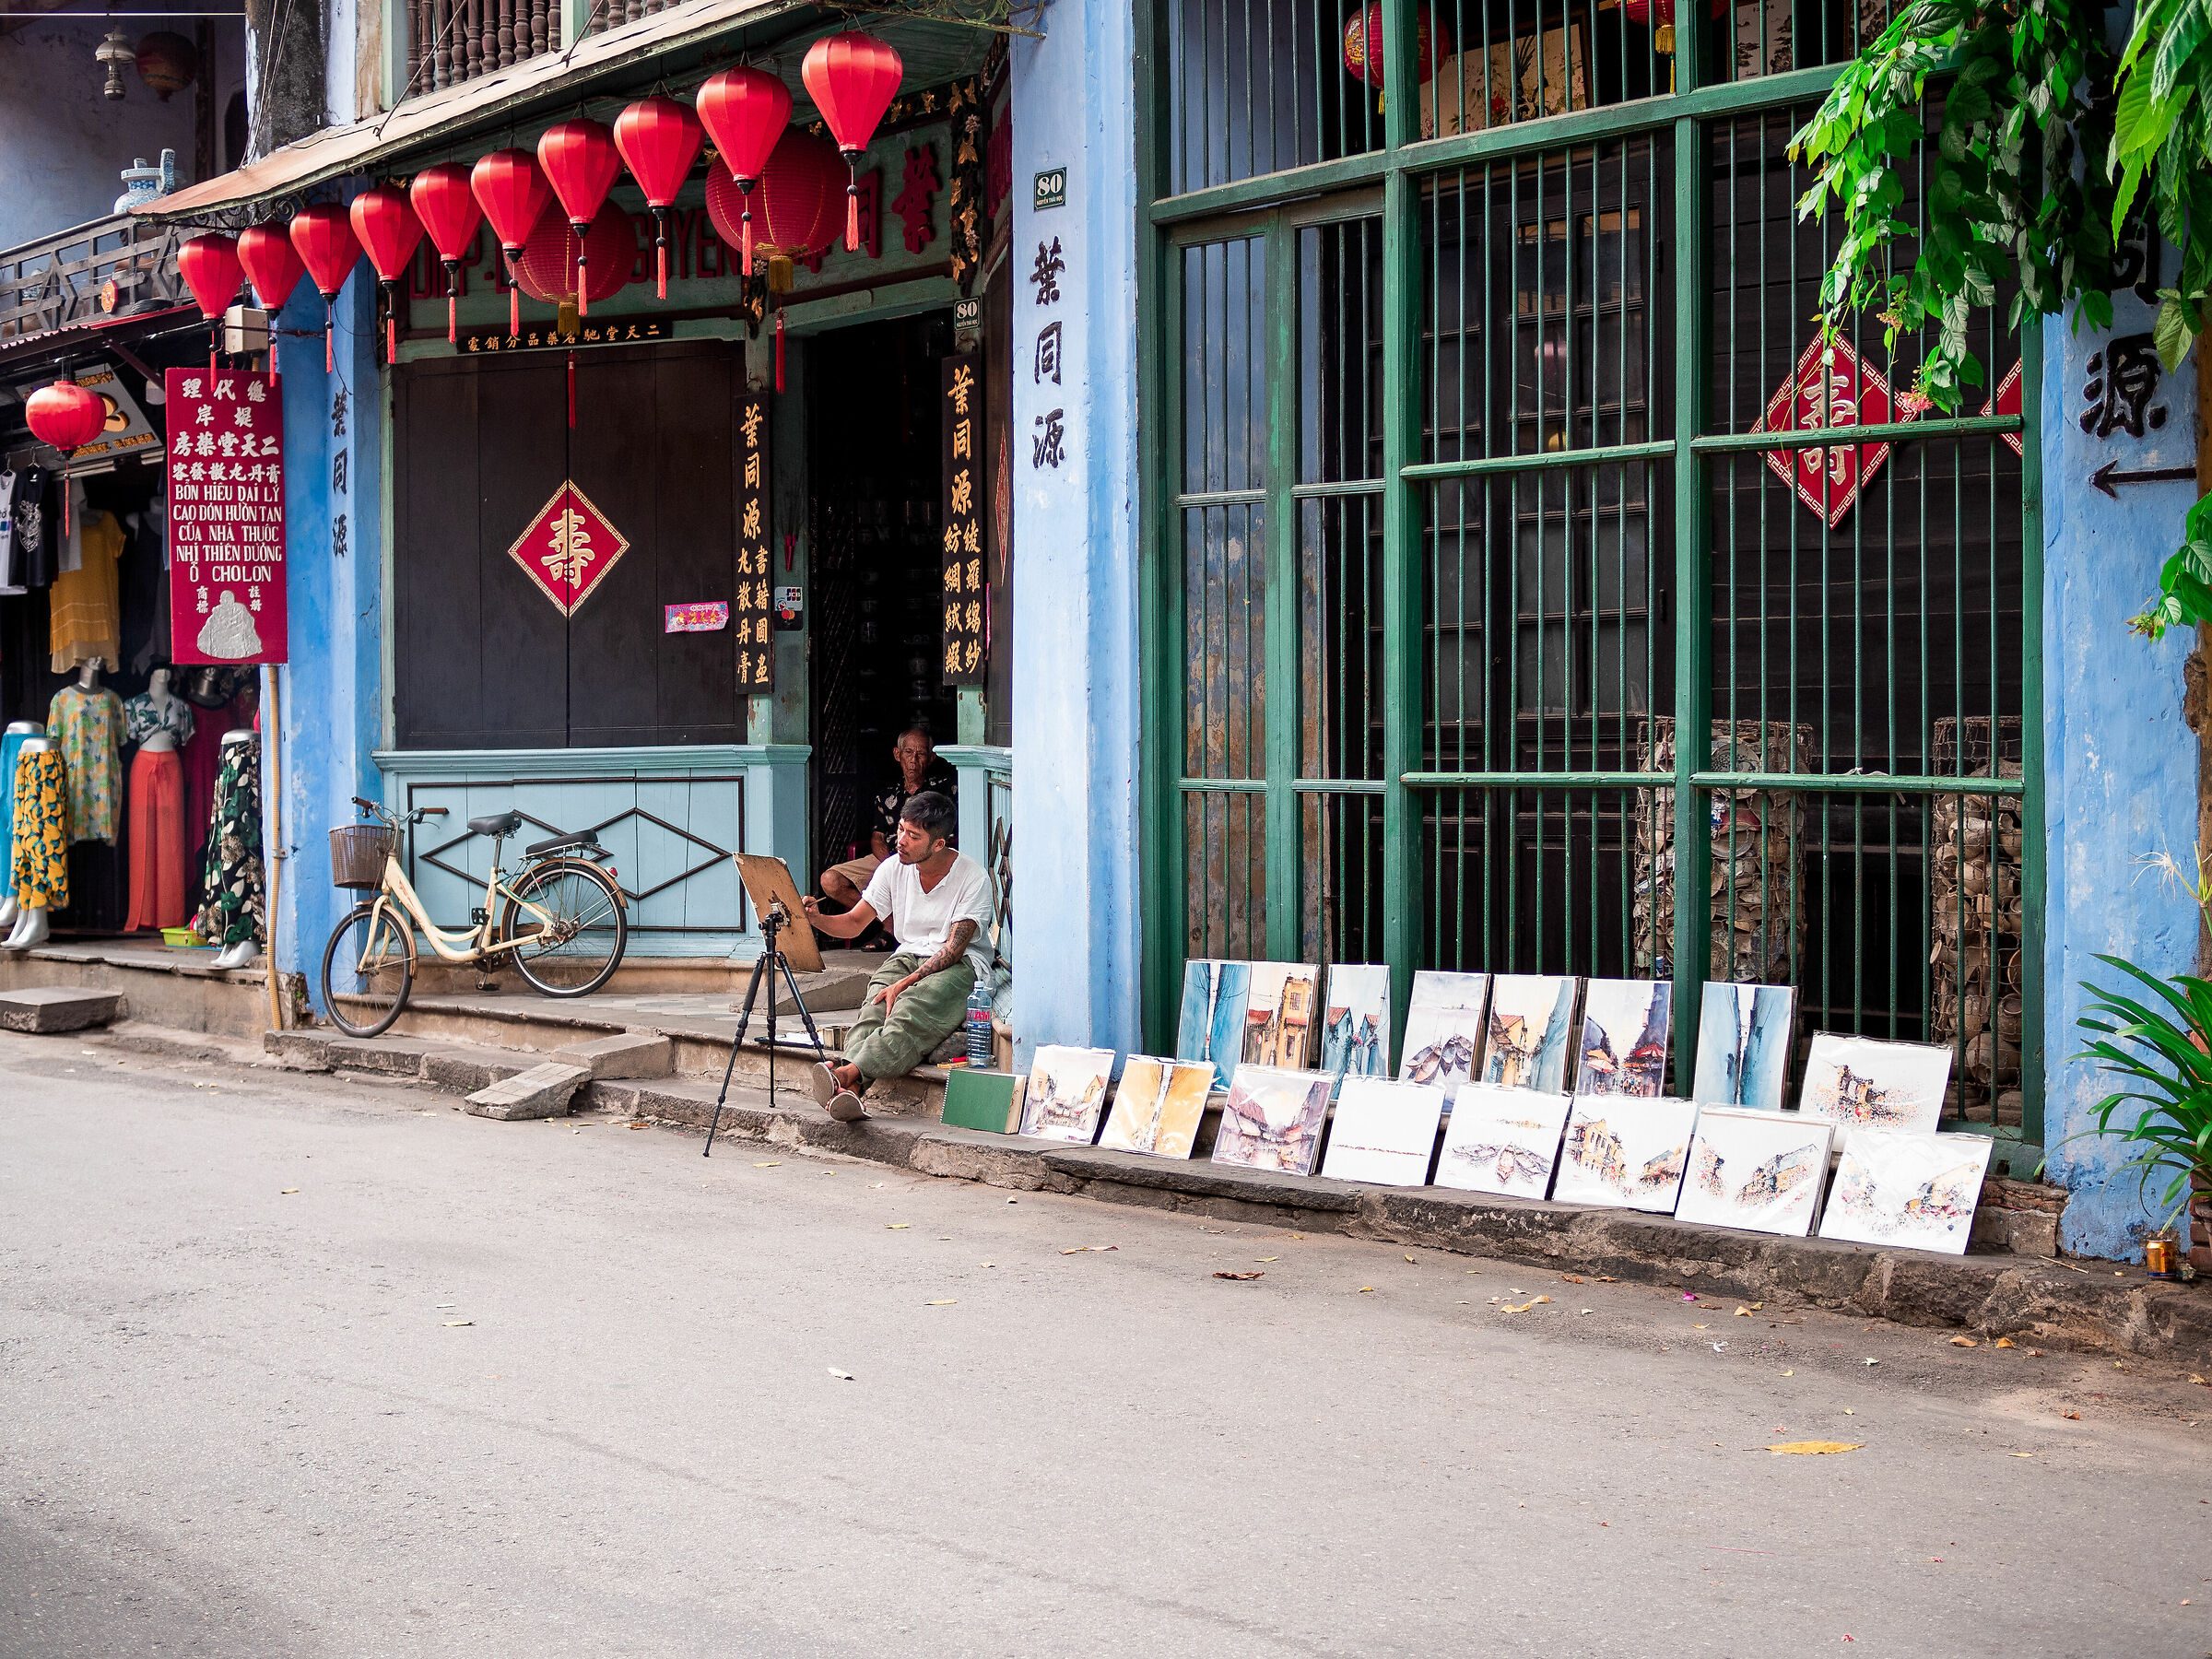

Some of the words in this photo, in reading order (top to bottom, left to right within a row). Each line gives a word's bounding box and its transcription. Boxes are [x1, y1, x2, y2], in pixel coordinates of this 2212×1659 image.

[1037, 174, 1063, 196] 80
[957, 301, 977, 319] 80
[1030, 235, 1066, 469] 葉同源
[947, 364, 975, 516] 葉同源
[740, 403, 763, 541] 葉同源
[265, 484, 280, 502] LÝ
[173, 504, 196, 521] CAO
[259, 505, 282, 523] TAN
[209, 523, 235, 542] NHÀ
[203, 542, 240, 562] THIÊN
[540, 508, 595, 590] 壽
[212, 565, 272, 582] CHOLON
